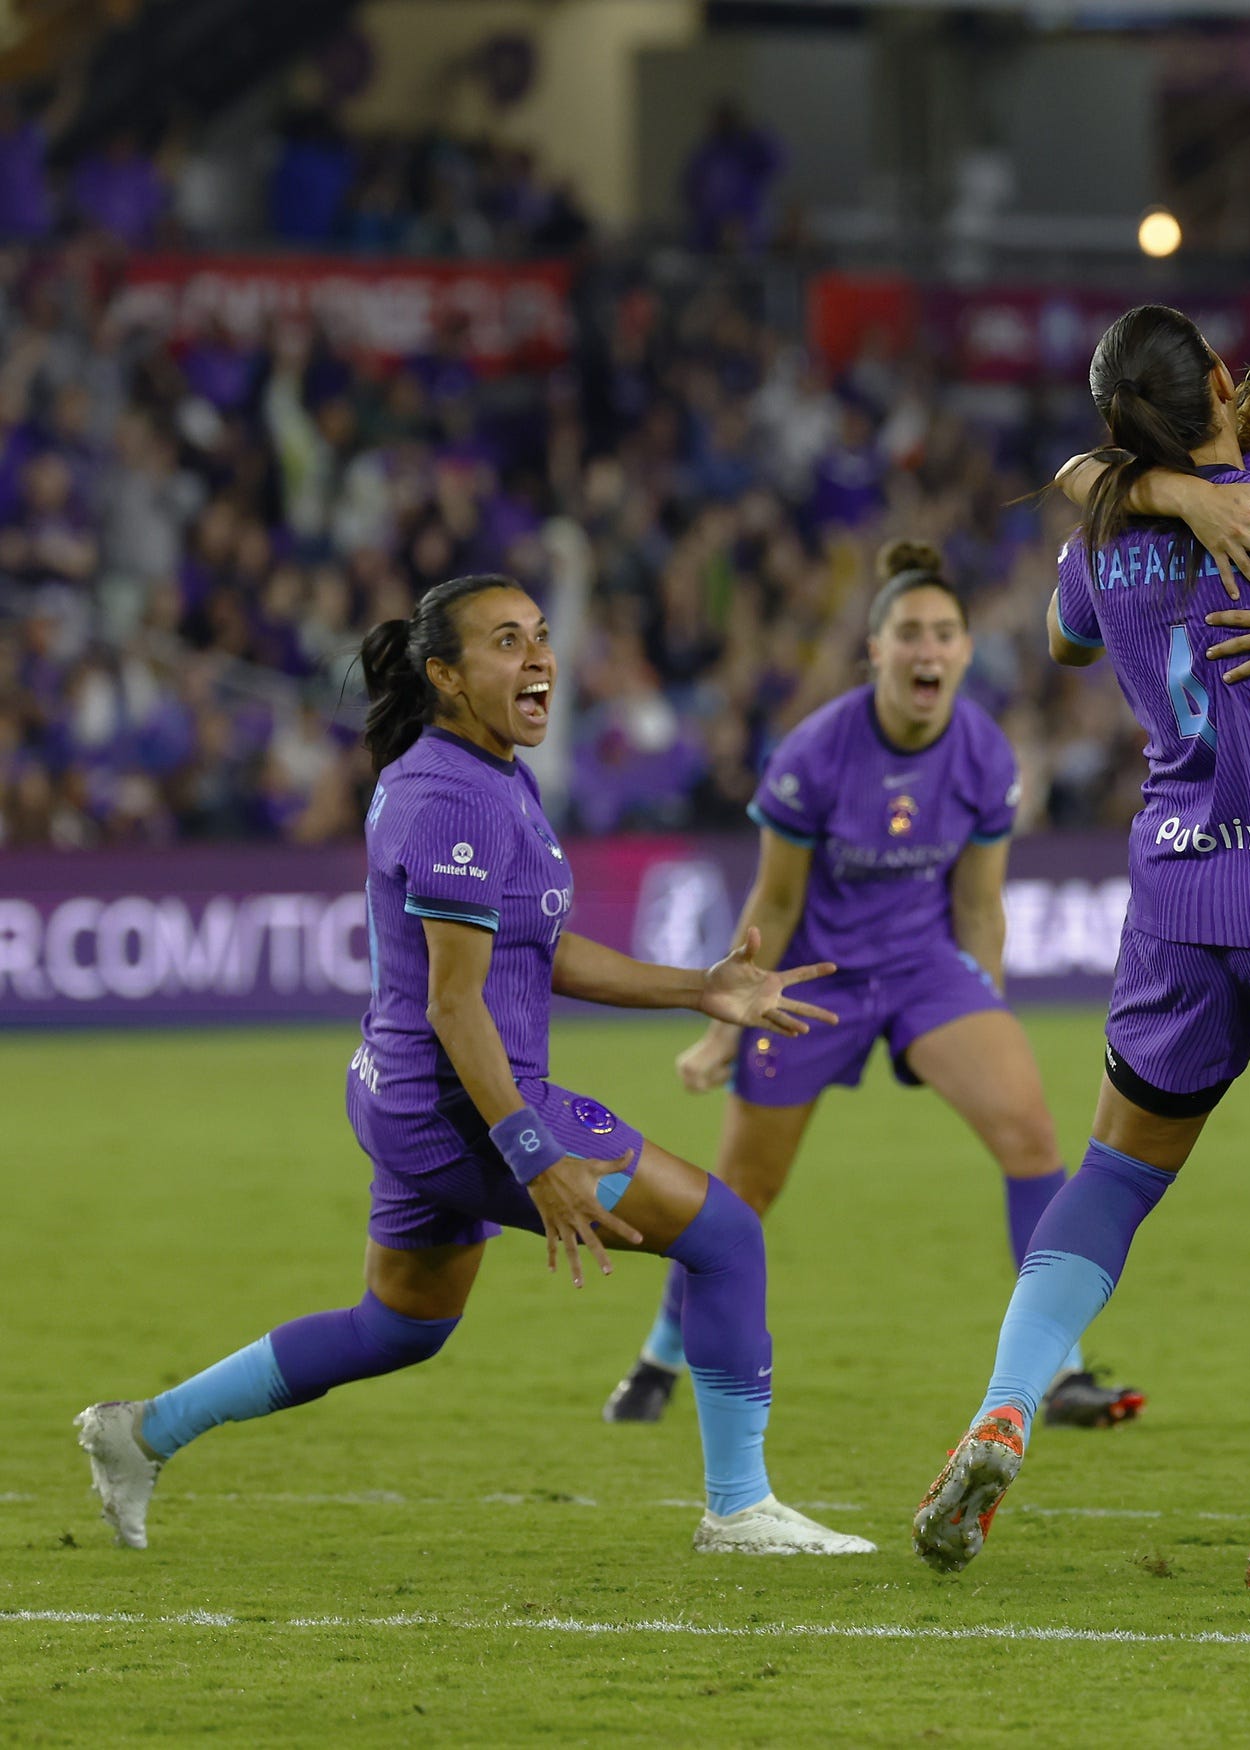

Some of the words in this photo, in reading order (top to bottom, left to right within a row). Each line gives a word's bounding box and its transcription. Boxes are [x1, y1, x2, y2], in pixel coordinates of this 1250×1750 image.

[433, 863, 467, 876] United
[469, 866, 488, 881] Way
[519, 1129, 540, 1152] 8
